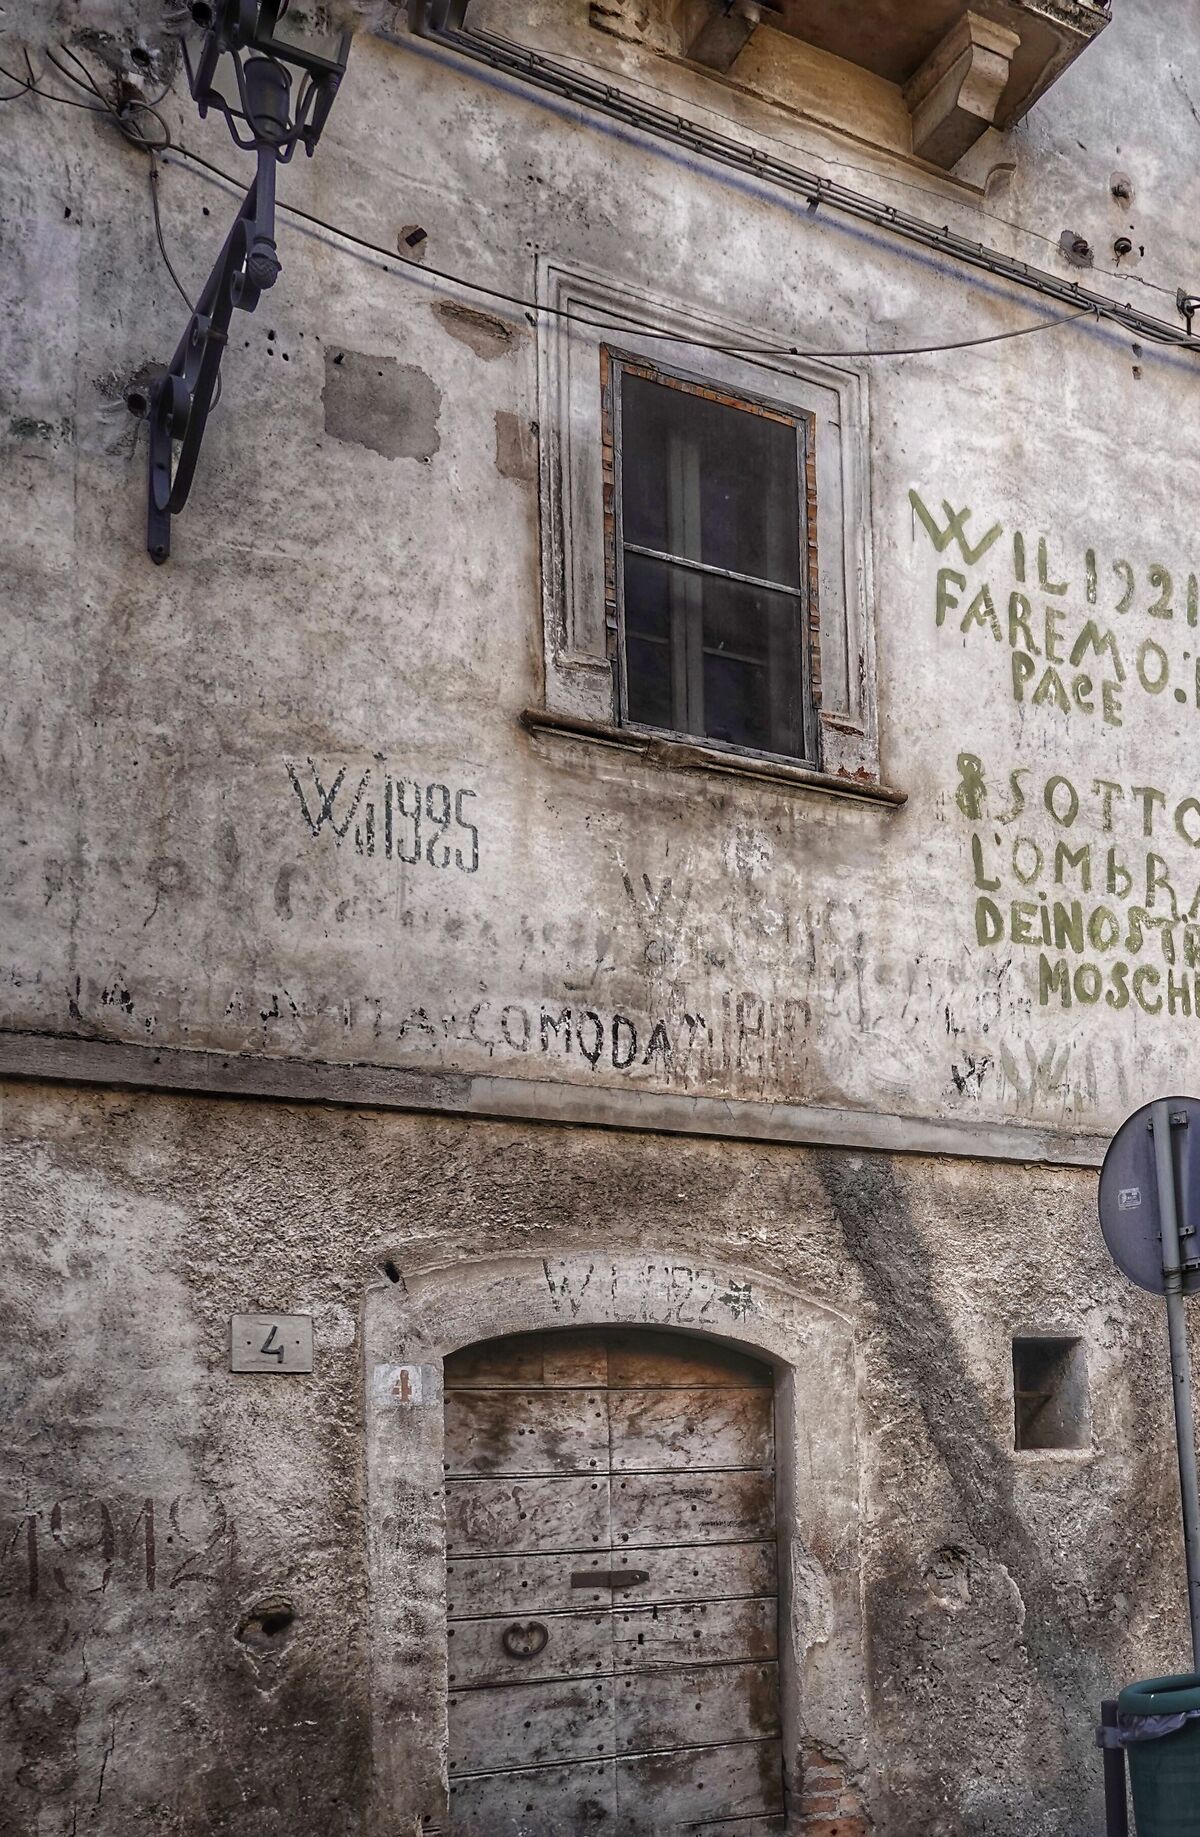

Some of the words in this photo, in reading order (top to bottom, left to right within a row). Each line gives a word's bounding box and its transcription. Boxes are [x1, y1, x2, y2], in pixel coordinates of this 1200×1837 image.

[909, 489, 1003, 565] W
[1085, 548, 1198, 627] 1921
[1012, 651, 1123, 727] PACE
[260, 1325, 284, 1364] 4
